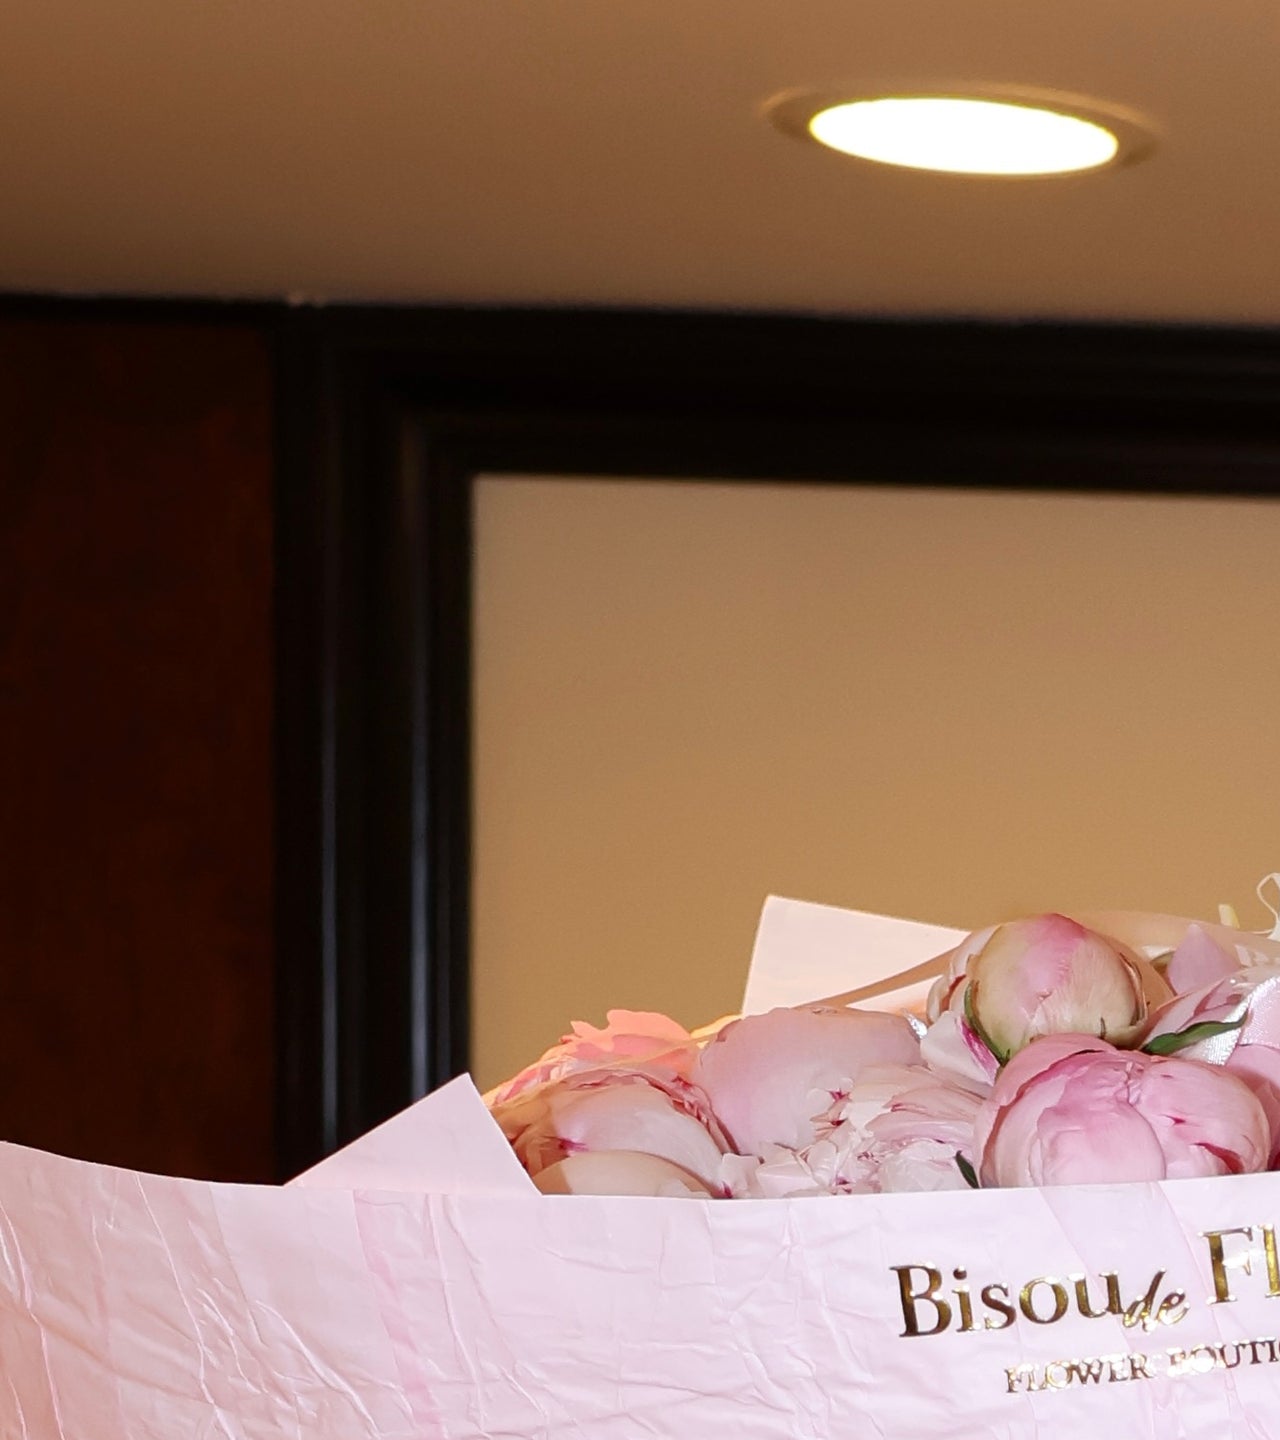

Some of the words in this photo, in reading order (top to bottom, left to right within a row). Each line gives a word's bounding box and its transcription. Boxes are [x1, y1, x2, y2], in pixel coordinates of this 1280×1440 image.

[890, 1261, 1124, 1338] Bisou
[1122, 1268, 1189, 1332] de
[1004, 1352, 1151, 1394] FLOWER
